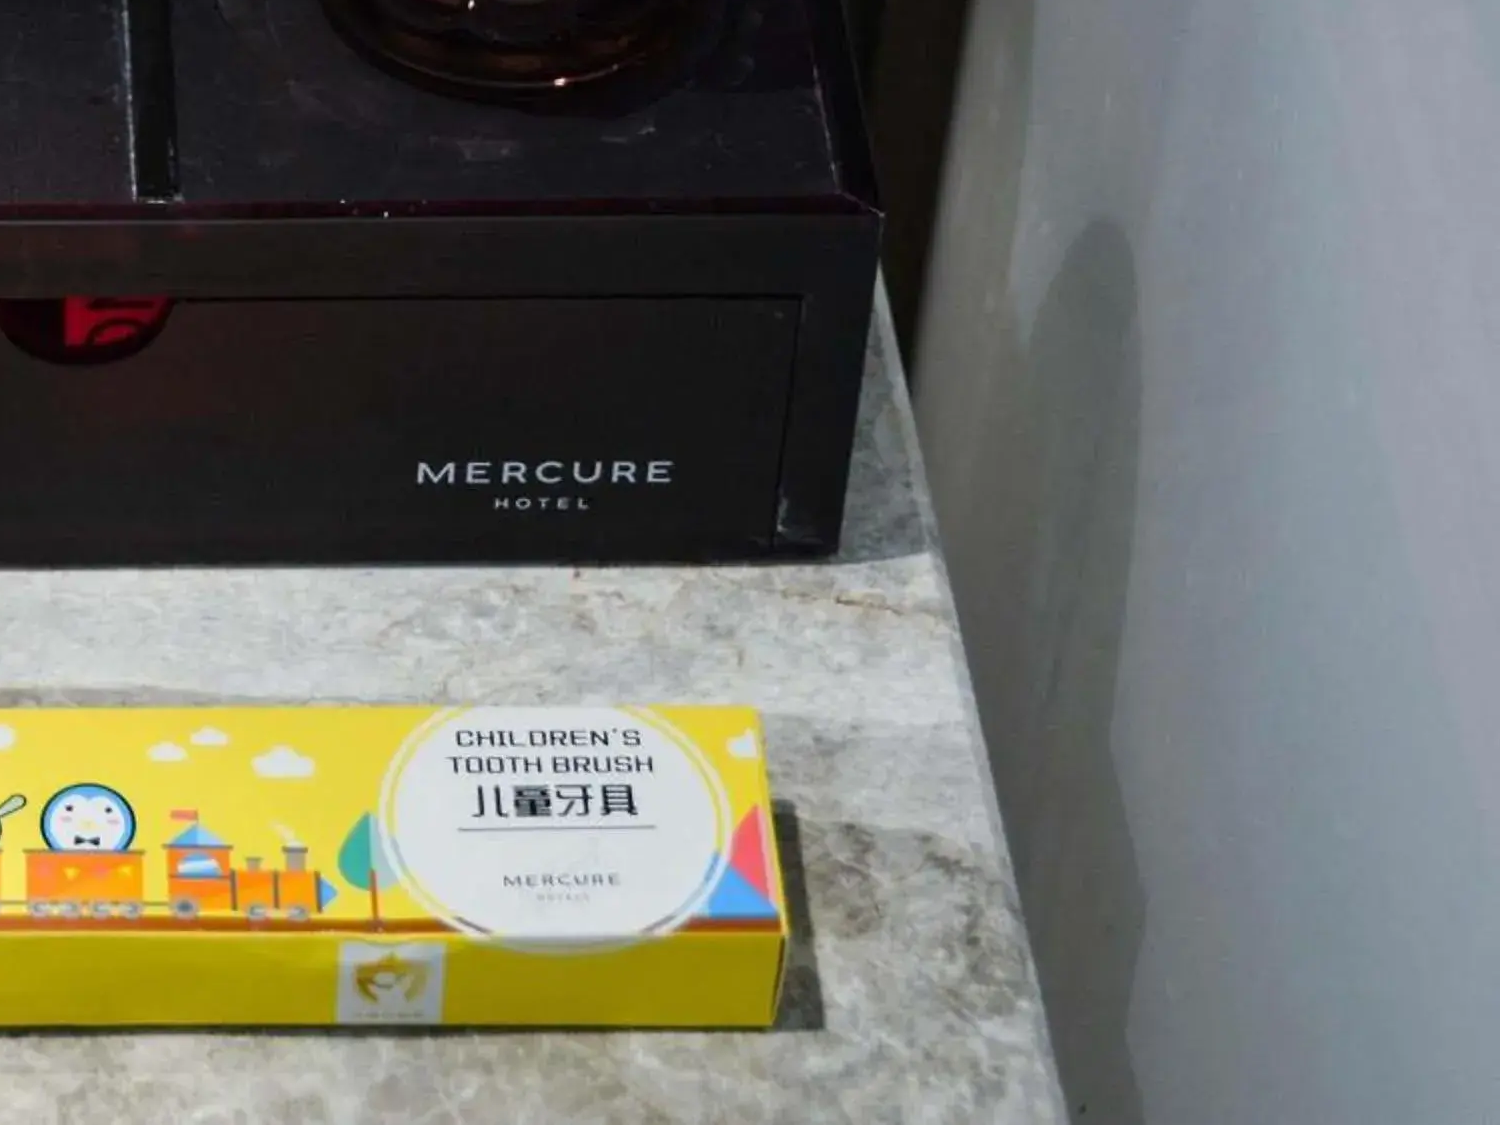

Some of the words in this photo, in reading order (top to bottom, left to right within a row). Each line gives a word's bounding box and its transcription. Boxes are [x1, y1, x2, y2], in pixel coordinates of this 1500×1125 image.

[416, 461, 674, 484] MERCURE
[494, 497, 590, 510] HOTEL
[455, 728, 642, 747] CHILDREN'S
[447, 755, 543, 774] TOOTH
[551, 755, 654, 774] BRUSH
[471, 783, 639, 818] 儿童牙具
[502, 873, 620, 887] MERCURE
